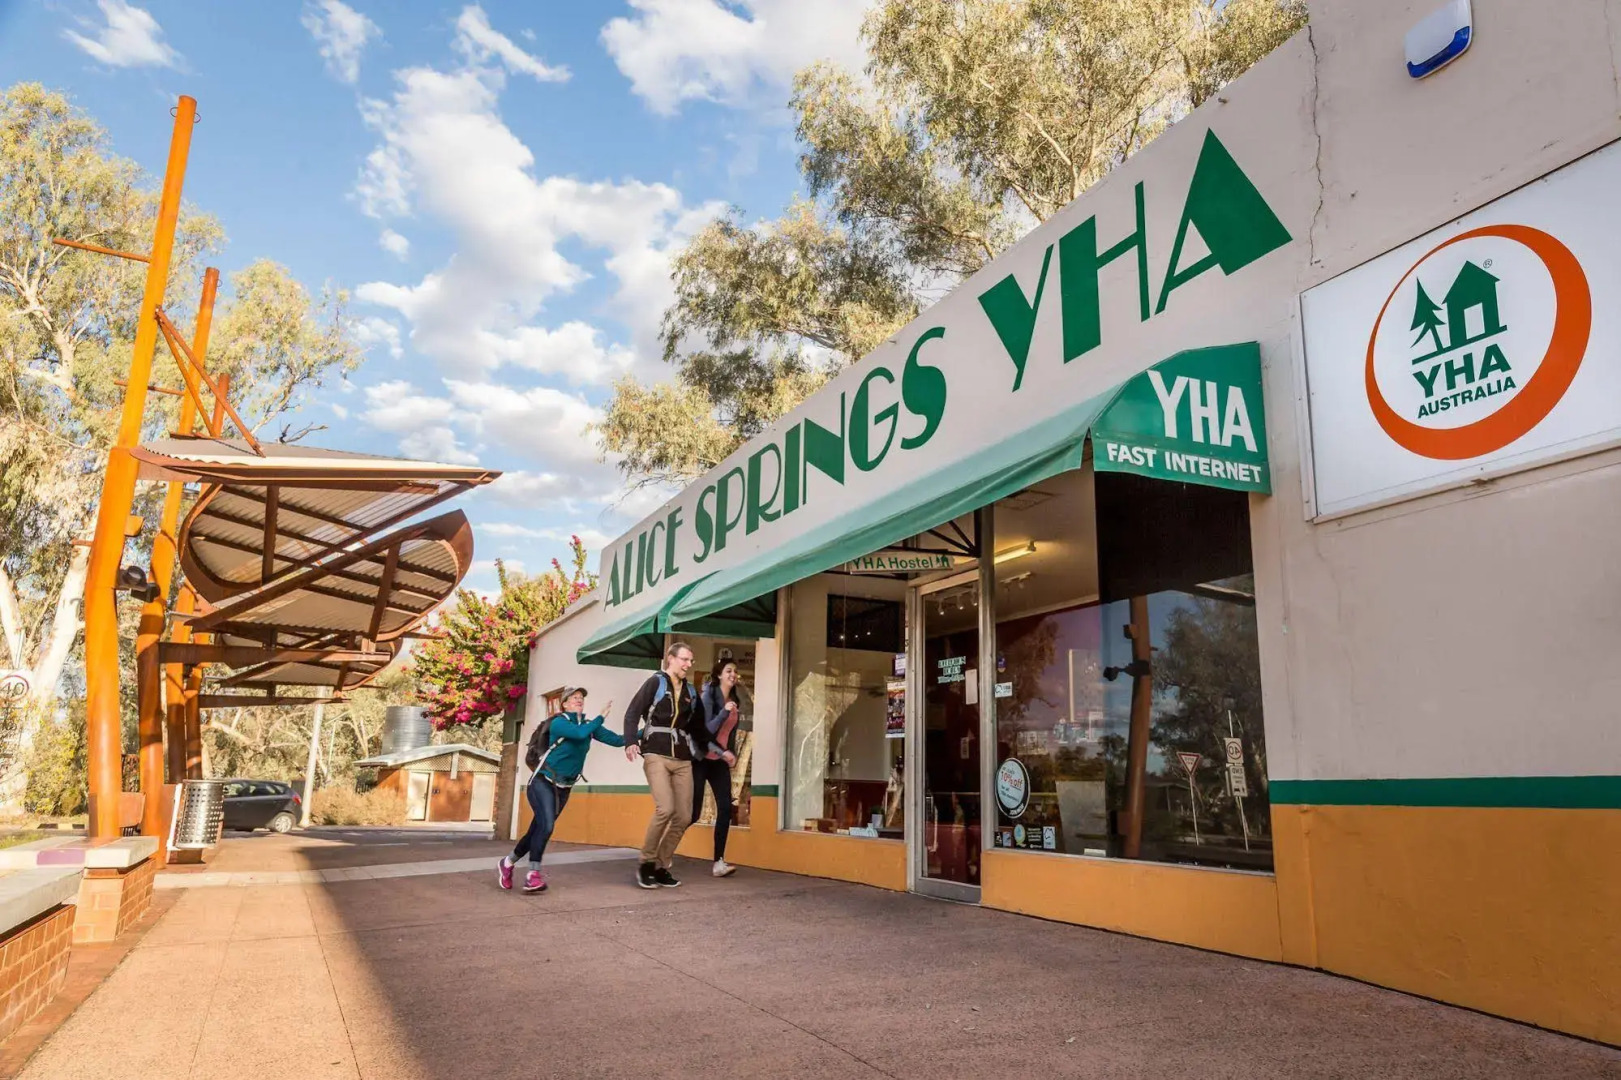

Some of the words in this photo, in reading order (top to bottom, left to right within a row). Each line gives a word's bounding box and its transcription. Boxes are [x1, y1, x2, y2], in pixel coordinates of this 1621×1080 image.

[603, 507, 684, 612] ALICE
[693, 326, 948, 563] SPRINGS
[978, 127, 1292, 392] YHA
[1412, 343, 1512, 399] YHA
[1146, 369, 1258, 453] YHA
[1417, 376, 1517, 419] AUSTRALIA
[1106, 442, 1157, 468] FAST
[1165, 451, 1262, 484] INTERNET
[853, 557, 885, 570] YHA
[888, 556, 934, 570] Hostel
[0, 682, 25, 697] 40
